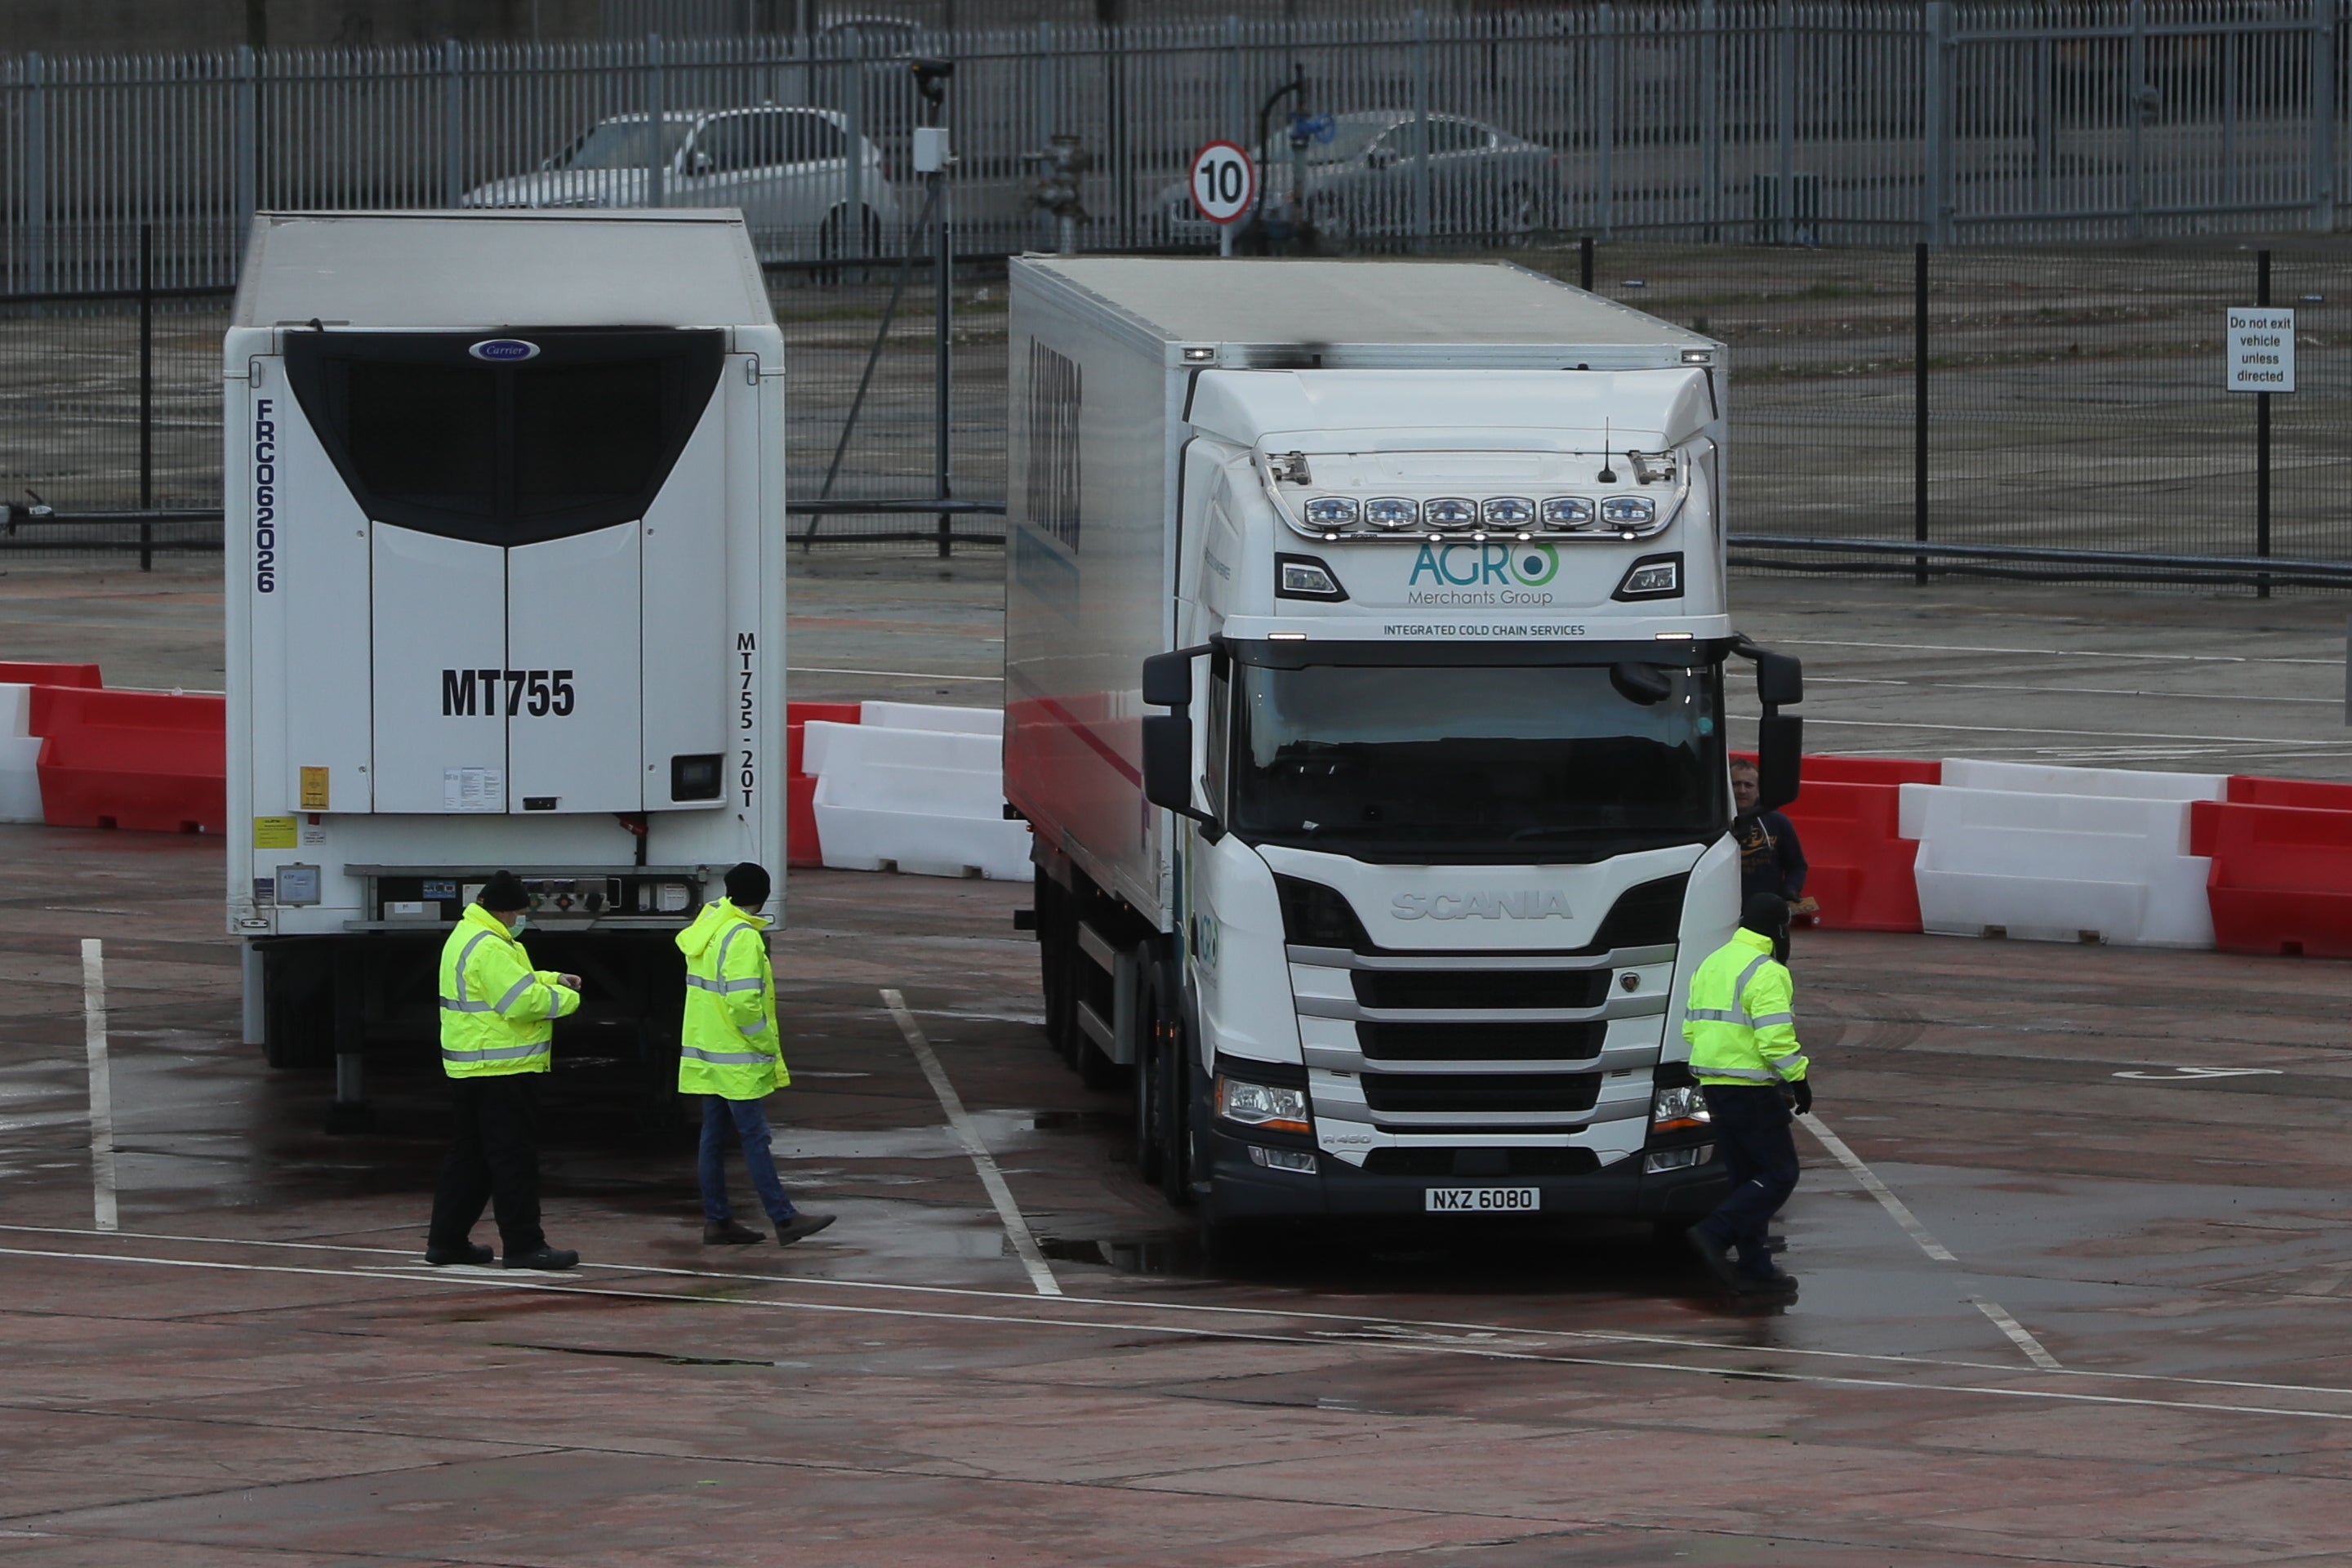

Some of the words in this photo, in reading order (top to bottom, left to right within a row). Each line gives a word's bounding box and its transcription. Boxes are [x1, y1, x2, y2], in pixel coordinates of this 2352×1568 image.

[1200, 160, 1243, 204] 10
[2230, 317, 2246, 328] Do
[2249, 318, 2267, 328] not
[2270, 317, 2290, 329] exit
[2240, 335, 2280, 346] vehicle
[486, 345, 523, 354] Carrier
[2242, 353, 2279, 364] unless
[2237, 369, 2283, 382] directed
[256, 399, 274, 593] FRC062026
[1409, 543, 1559, 586] AGRO
[1409, 590, 1494, 604] Merchants
[1500, 590, 1552, 606] Group
[1383, 625, 1455, 635] INTEGRATED
[1459, 625, 1489, 635] COLD
[1492, 625, 1527, 635] CHAIN
[1530, 625, 1585, 636] SERVICES
[443, 670, 574, 717] MT755
[1391, 890, 1574, 920] SCANIA
[1323, 1134, 1334, 1144] R
[1337, 1134, 1372, 1144] 450
[1433, 1190, 1473, 1209] NXZ
[1479, 1190, 1532, 1209] 6080
